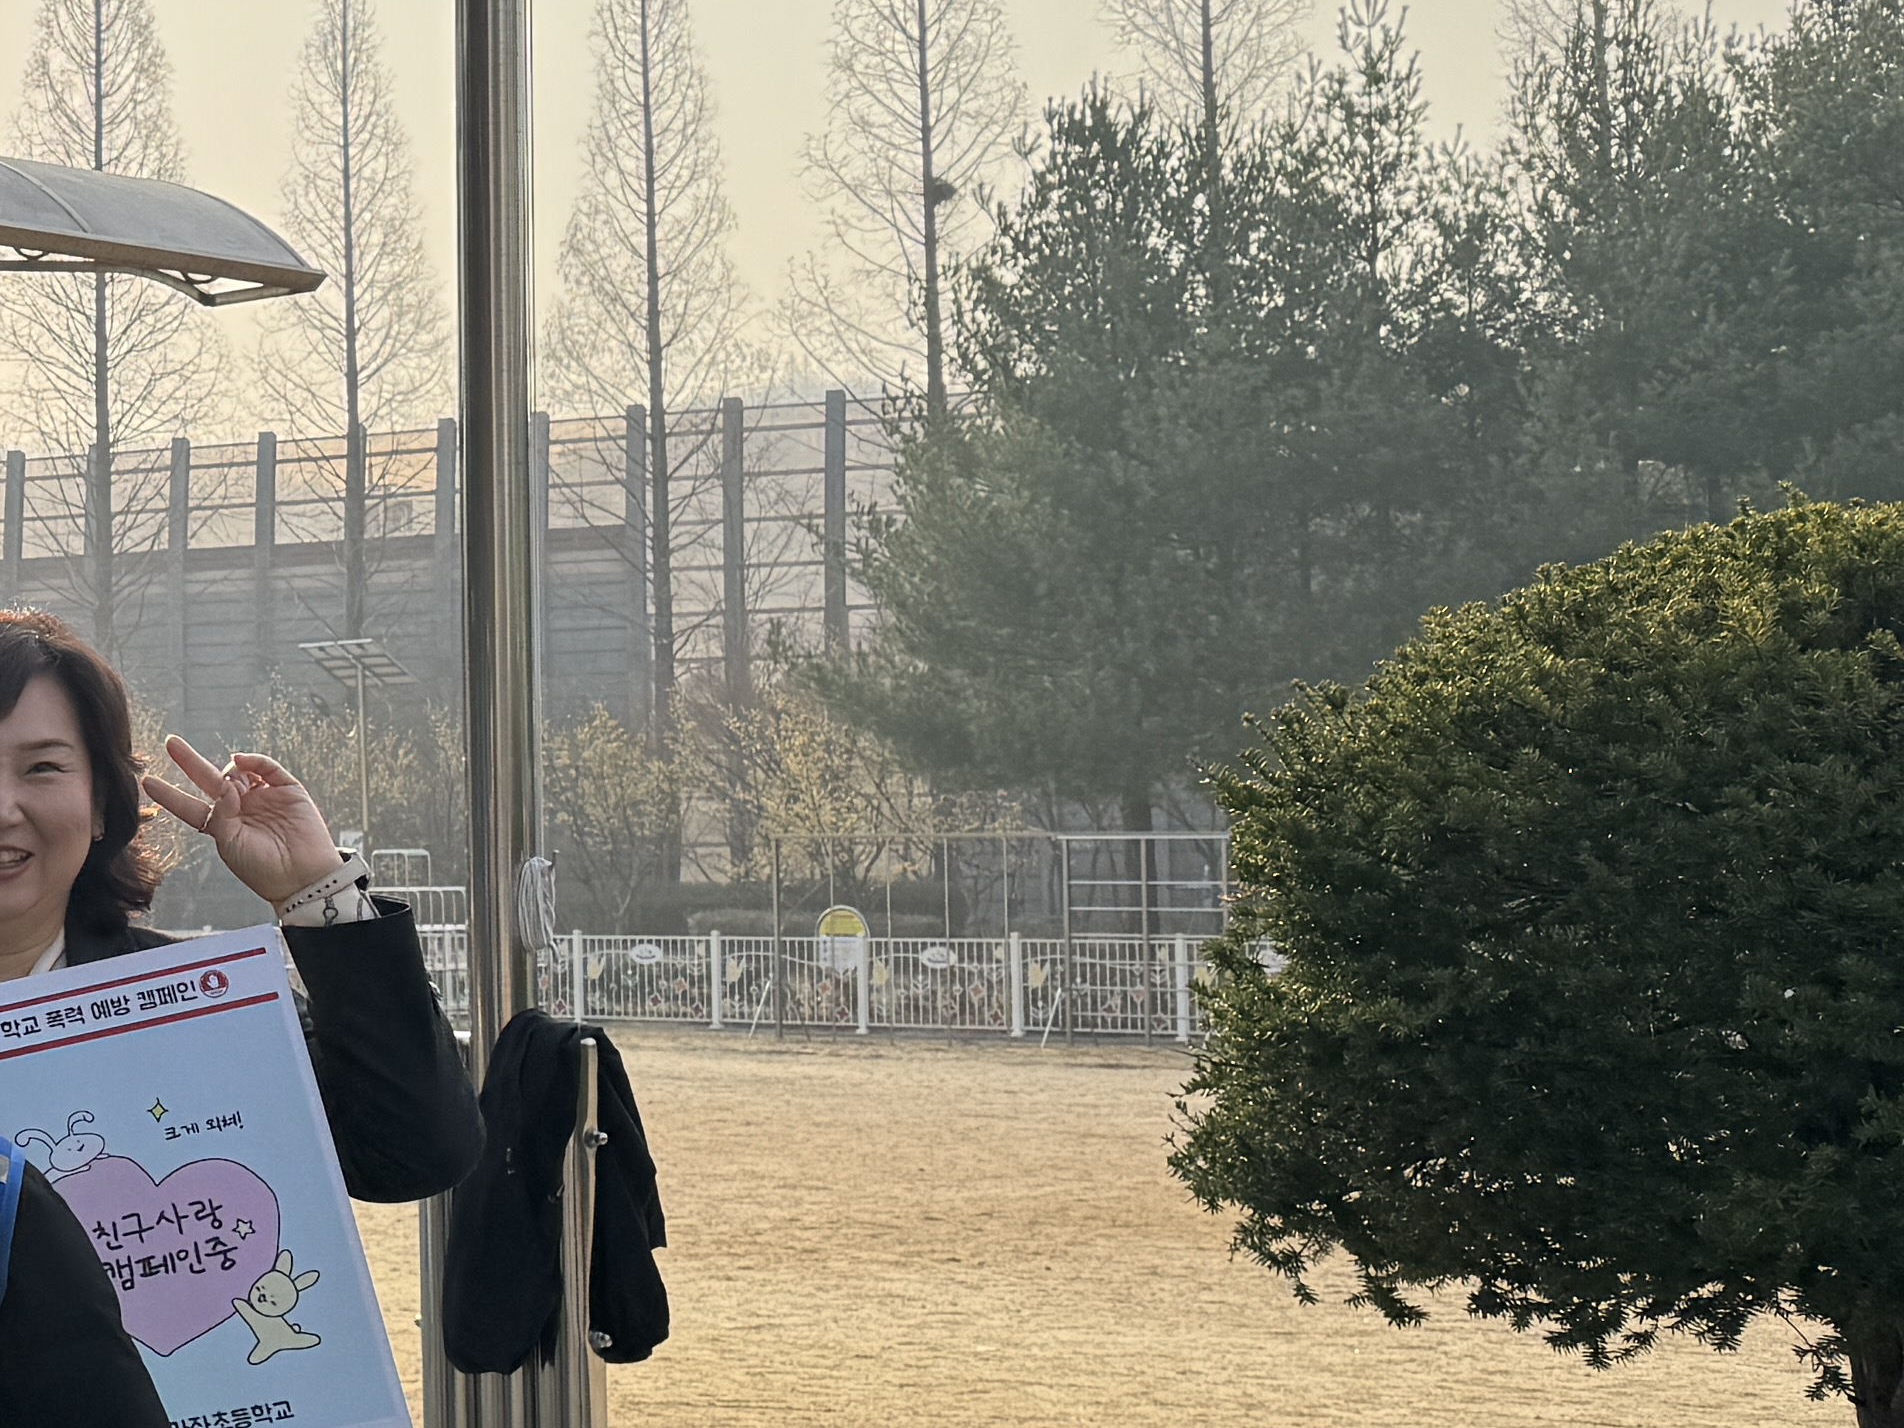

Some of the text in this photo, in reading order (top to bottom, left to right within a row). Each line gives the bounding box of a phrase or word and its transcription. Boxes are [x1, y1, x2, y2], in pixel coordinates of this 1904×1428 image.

[0, 980, 199, 1038] 학교 폭력 예방 캠페인
[164, 1111, 244, 1140] 크게 외쳐!
[92, 1198, 223, 1251] 친구사랑
[102, 1236, 238, 1291] 캠페인중
